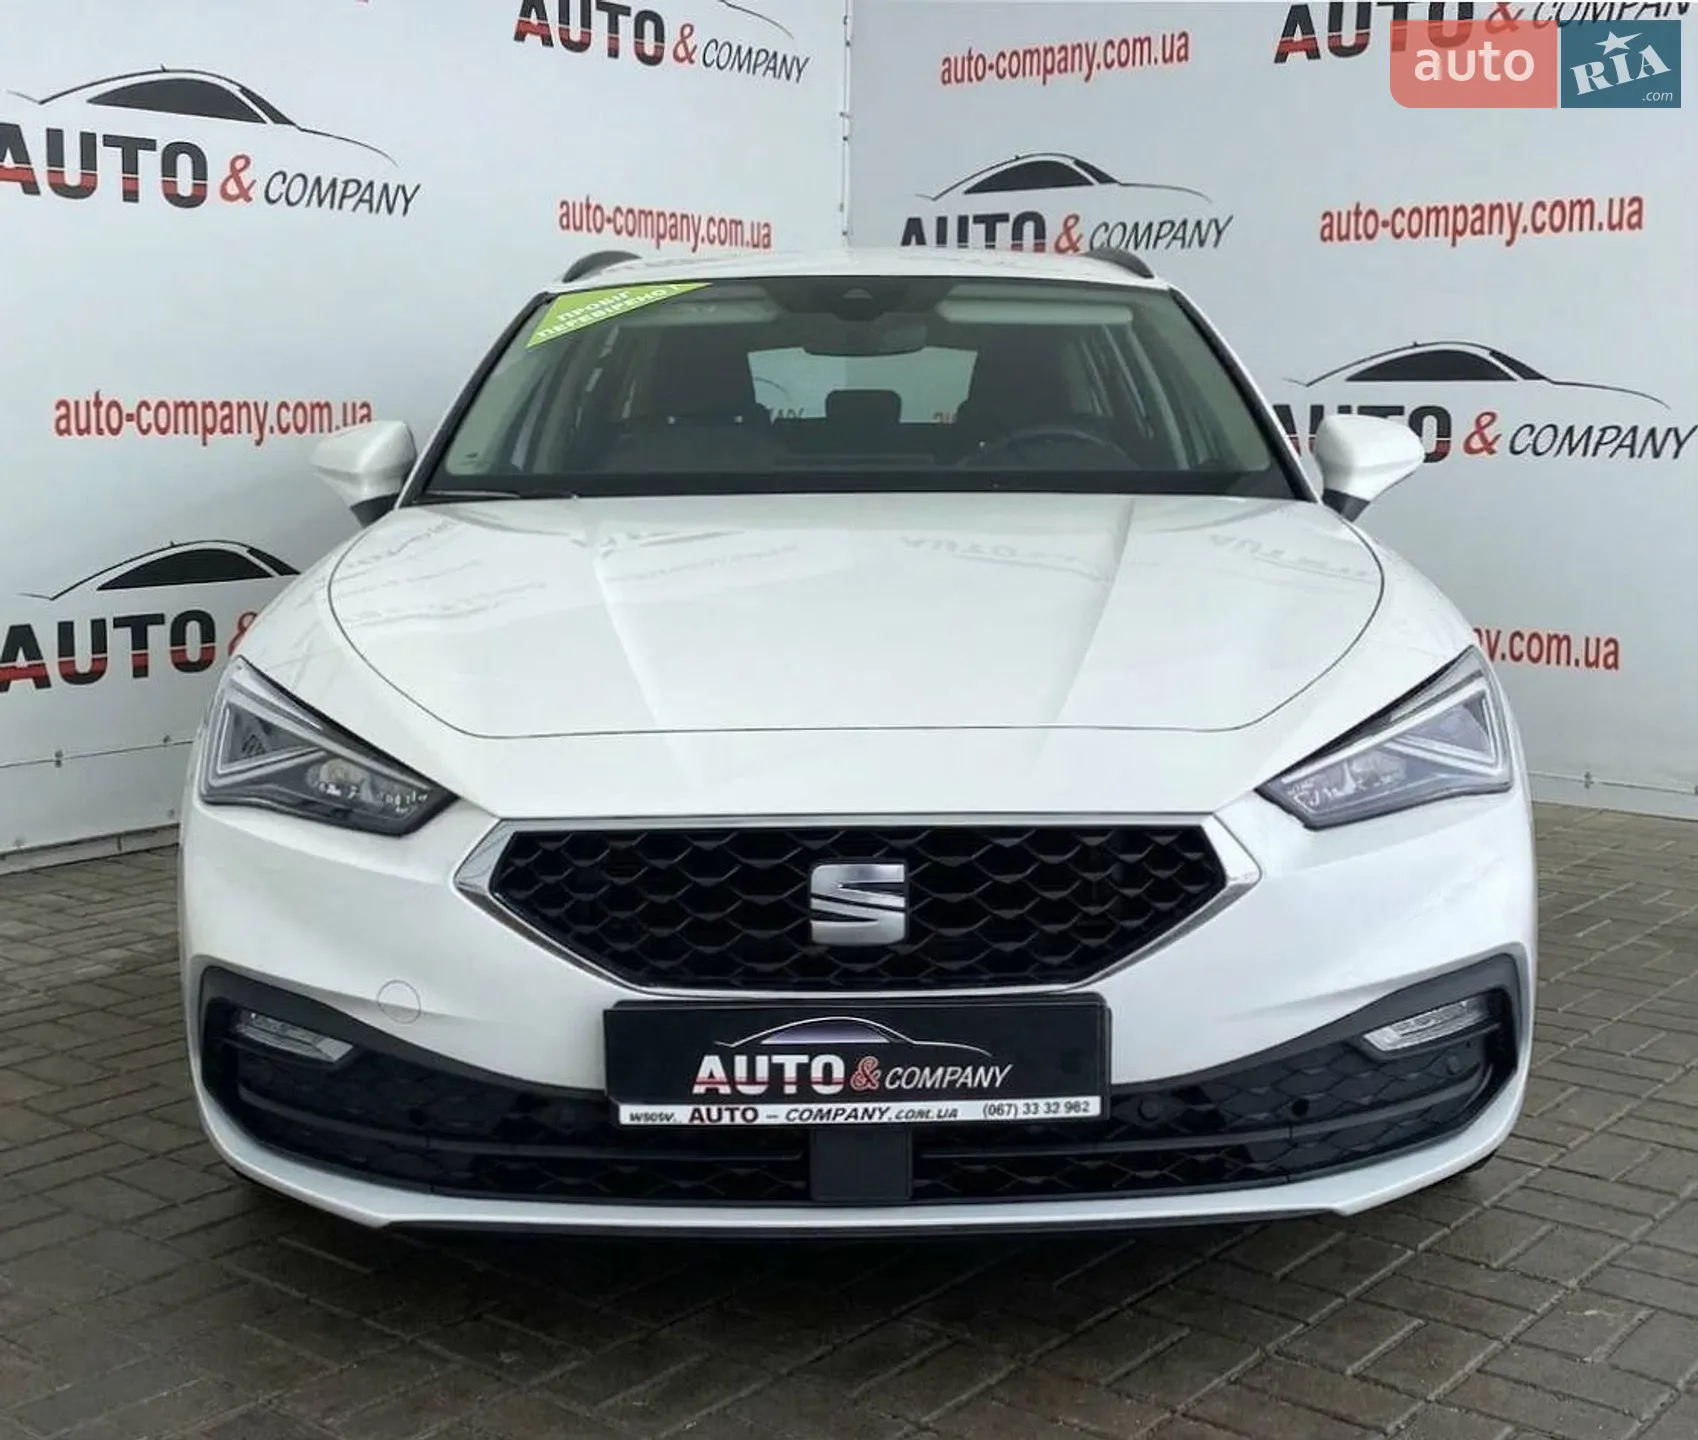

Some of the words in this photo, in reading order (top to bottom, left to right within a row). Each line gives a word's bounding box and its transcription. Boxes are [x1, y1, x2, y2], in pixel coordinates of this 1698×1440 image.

[513, 0, 665, 66] AUTO
[673, 23, 697, 64] &
[702, 39, 810, 83] COMPANY
[941, 30, 1189, 85] auto-company.com.ua
[0, 122, 208, 208] AUTO
[220, 154, 257, 203] &
[264, 170, 421, 217] COMPANY
[559, 194, 771, 253] auto-company.com.ua
[1054, 214, 1084, 253] &
[1089, 214, 1233, 251] COMPANY
[1320, 195, 1644, 247] auto-company.com.ua
[54, 390, 372, 446] auto-company.com.ua
[1462, 411, 1502, 456] &
[1508, 424, 1697, 461] COMPANY
[0, 609, 216, 693] AUTO
[692, 1054, 845, 1095] AUTO
[850, 1055, 882, 1091] &
[885, 1064, 1013, 1090] COMPANY
[689, 1107, 759, 1124] AUTO
[982, 1101, 1018, 1118] (067)
